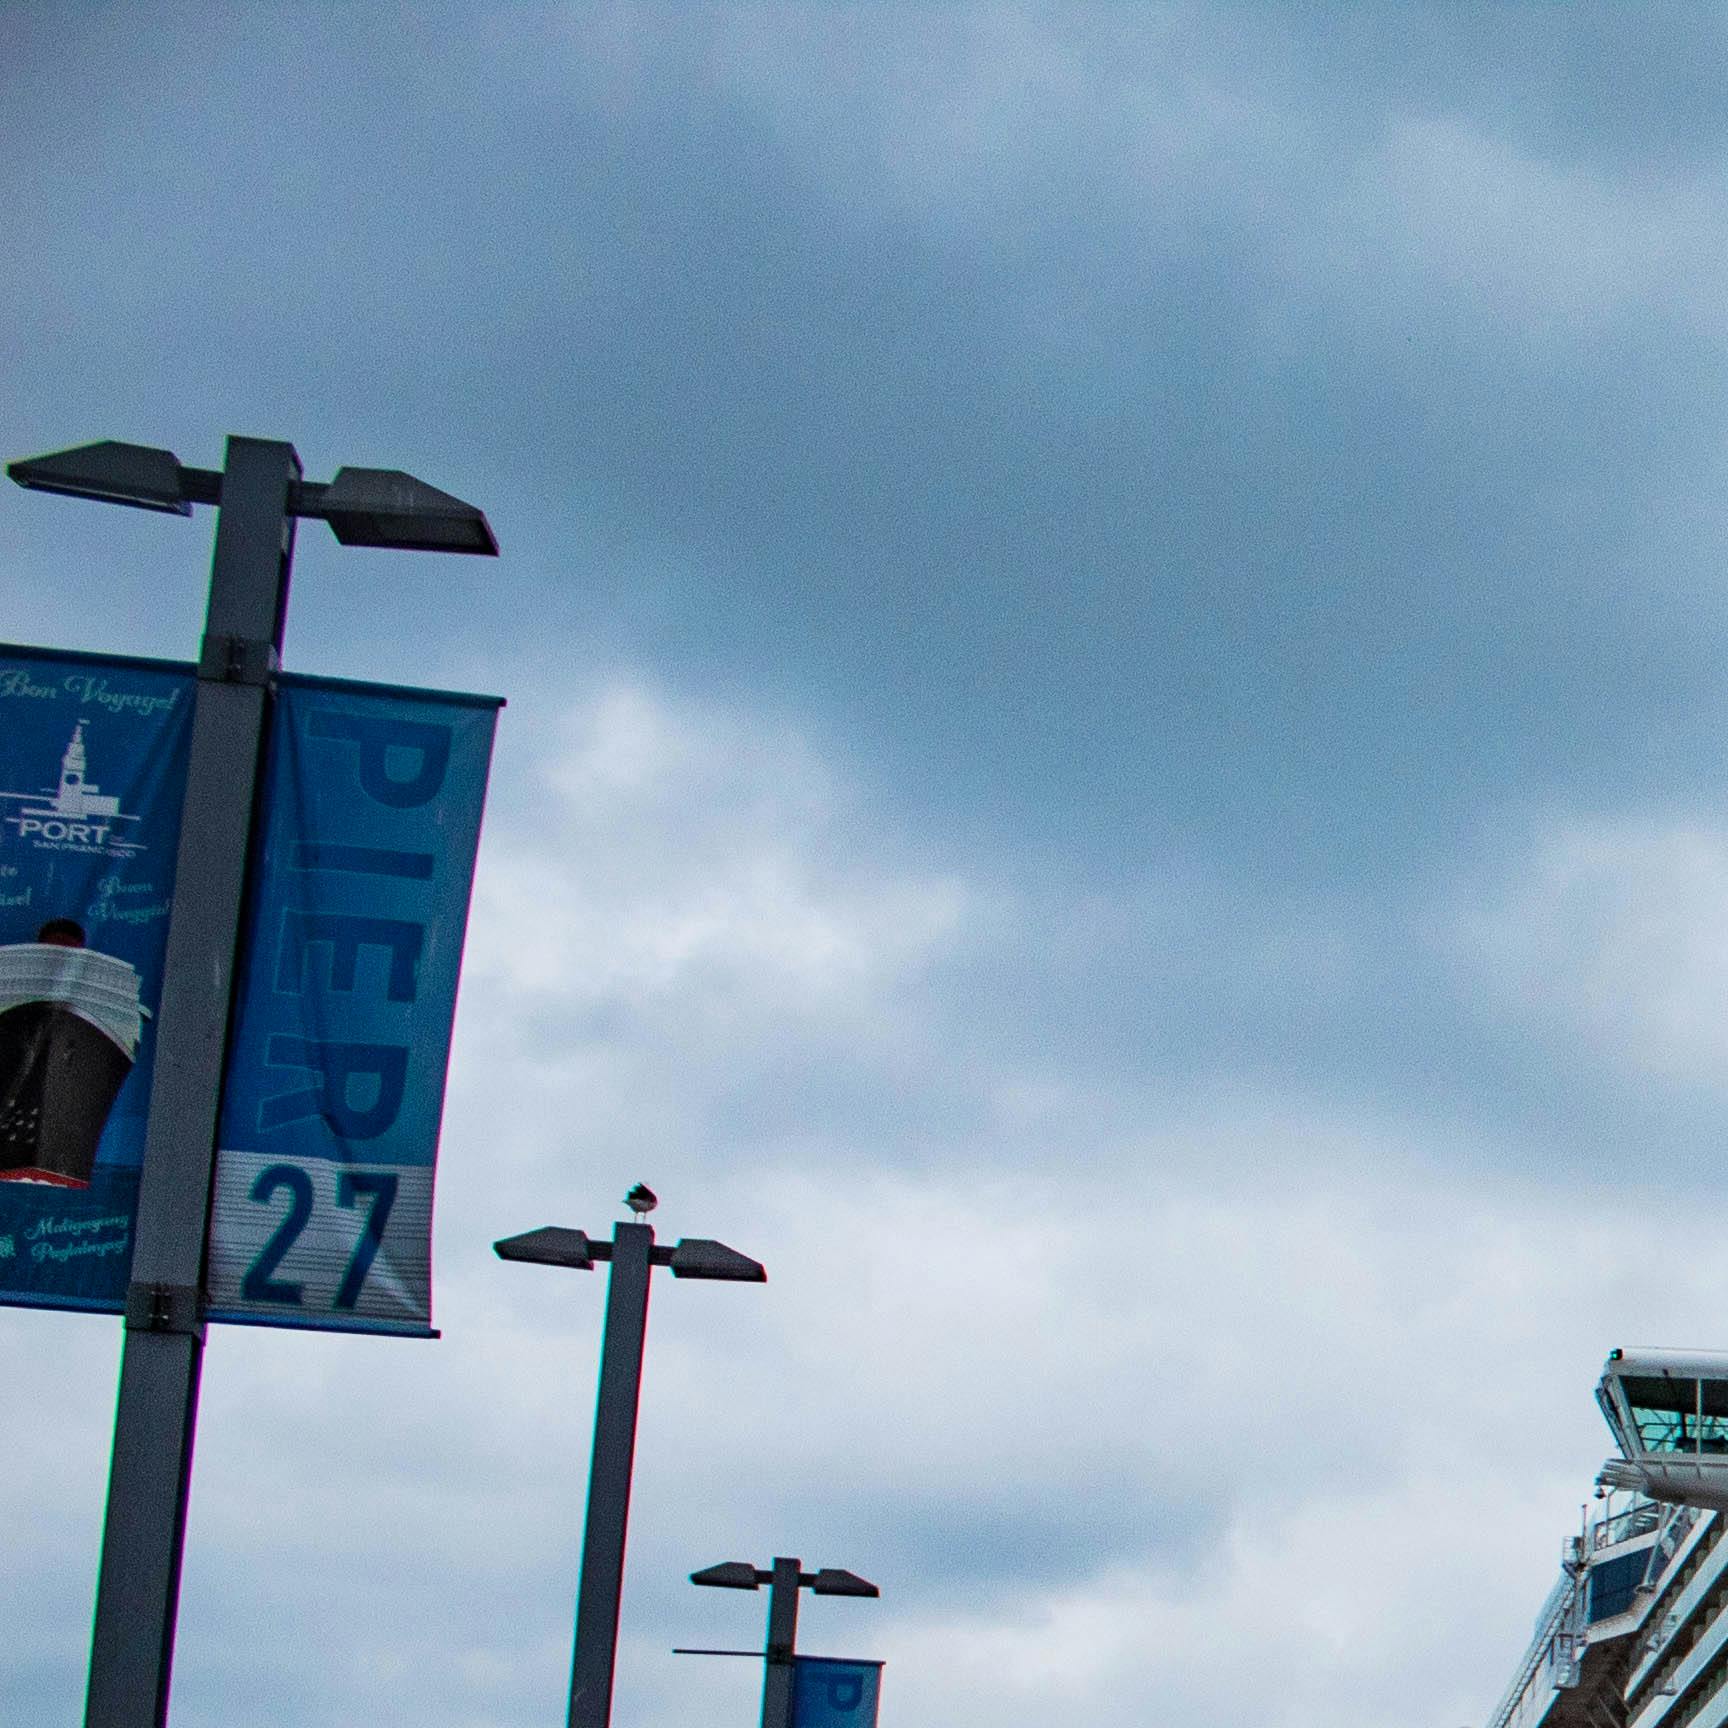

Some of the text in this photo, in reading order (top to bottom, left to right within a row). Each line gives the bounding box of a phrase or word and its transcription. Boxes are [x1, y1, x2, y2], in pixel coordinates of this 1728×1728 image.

[20, 819, 110, 844] PORT
[256, 708, 454, 1141] PIER
[239, 1163, 399, 1311] 27
